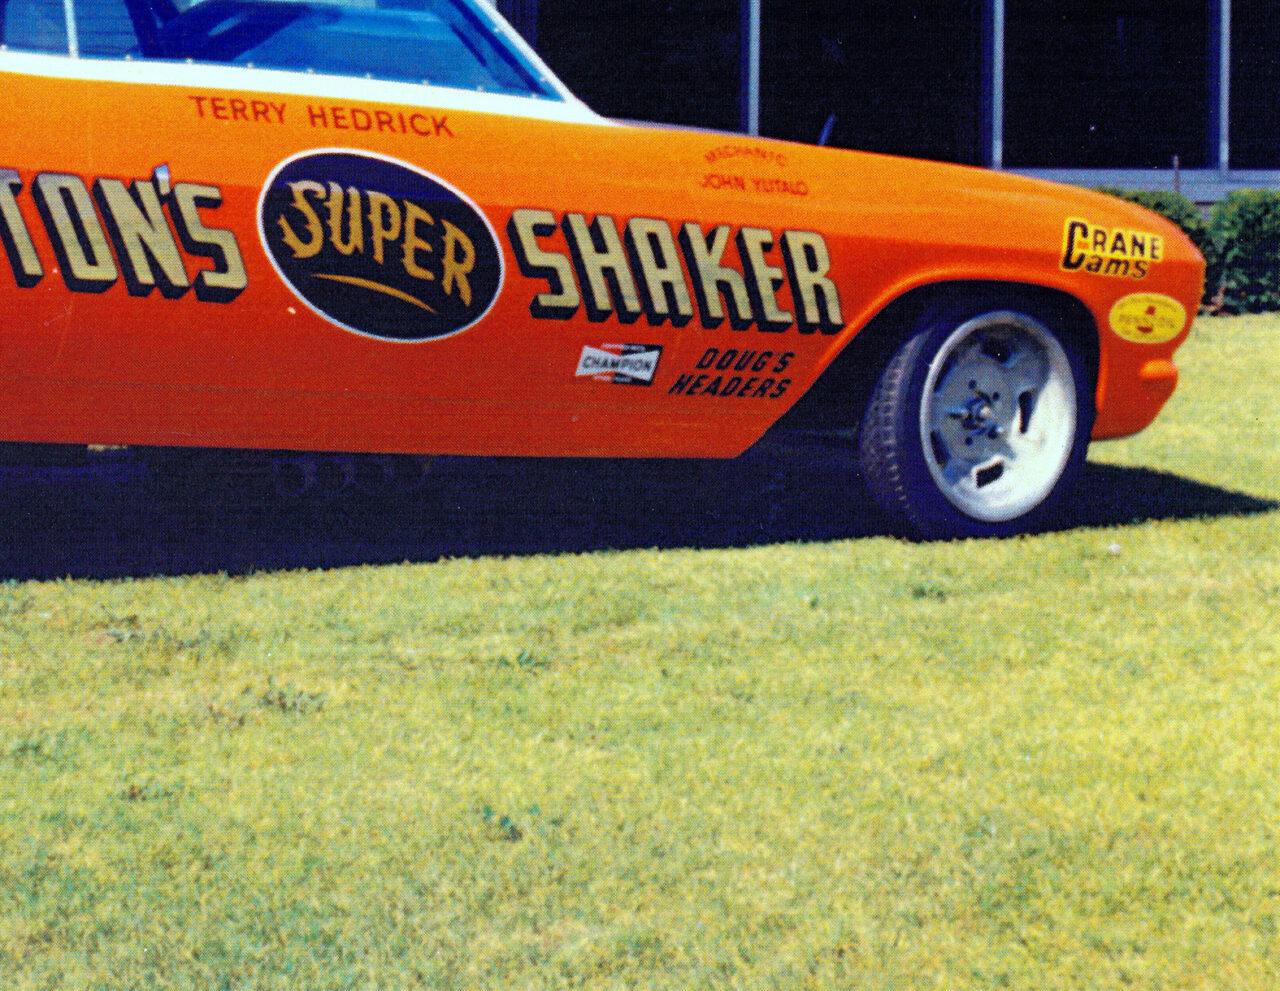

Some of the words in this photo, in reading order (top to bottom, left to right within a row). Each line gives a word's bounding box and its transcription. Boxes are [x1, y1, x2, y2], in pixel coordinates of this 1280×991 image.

[189, 95, 288, 125] TERRY
[307, 104, 455, 138] HEDRICK
[700, 173, 745, 191] JOHN
[277, 180, 475, 307] SUPER
[1063, 220, 1160, 270] CRANE
[506, 208, 845, 335] SHAKER
[582, 355, 652, 372] CHAMPION
[695, 347, 796, 373] DOUG'S
[668, 373, 792, 399] HEADERS
